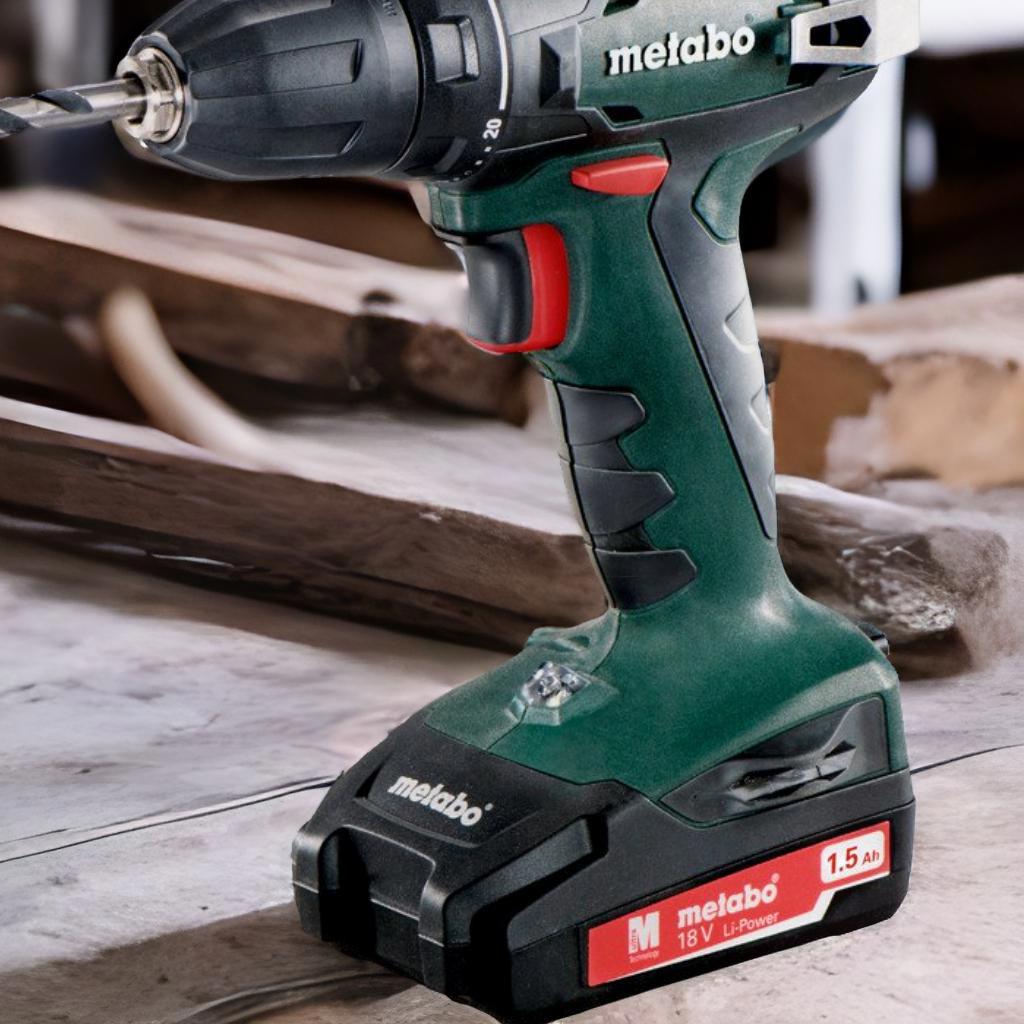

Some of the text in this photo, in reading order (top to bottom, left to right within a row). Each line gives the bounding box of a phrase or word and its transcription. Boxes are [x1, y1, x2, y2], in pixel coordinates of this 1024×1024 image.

[608, 23, 756, 76] metabo
[482, 118, 503, 140] 20
[386, 775, 483, 827] metabo
[827, 845, 880, 874] 1.5 Ah
[677, 883, 778, 929] metabo
[723, 912, 780, 937] Li-Power
[628, 911, 660, 954] M
